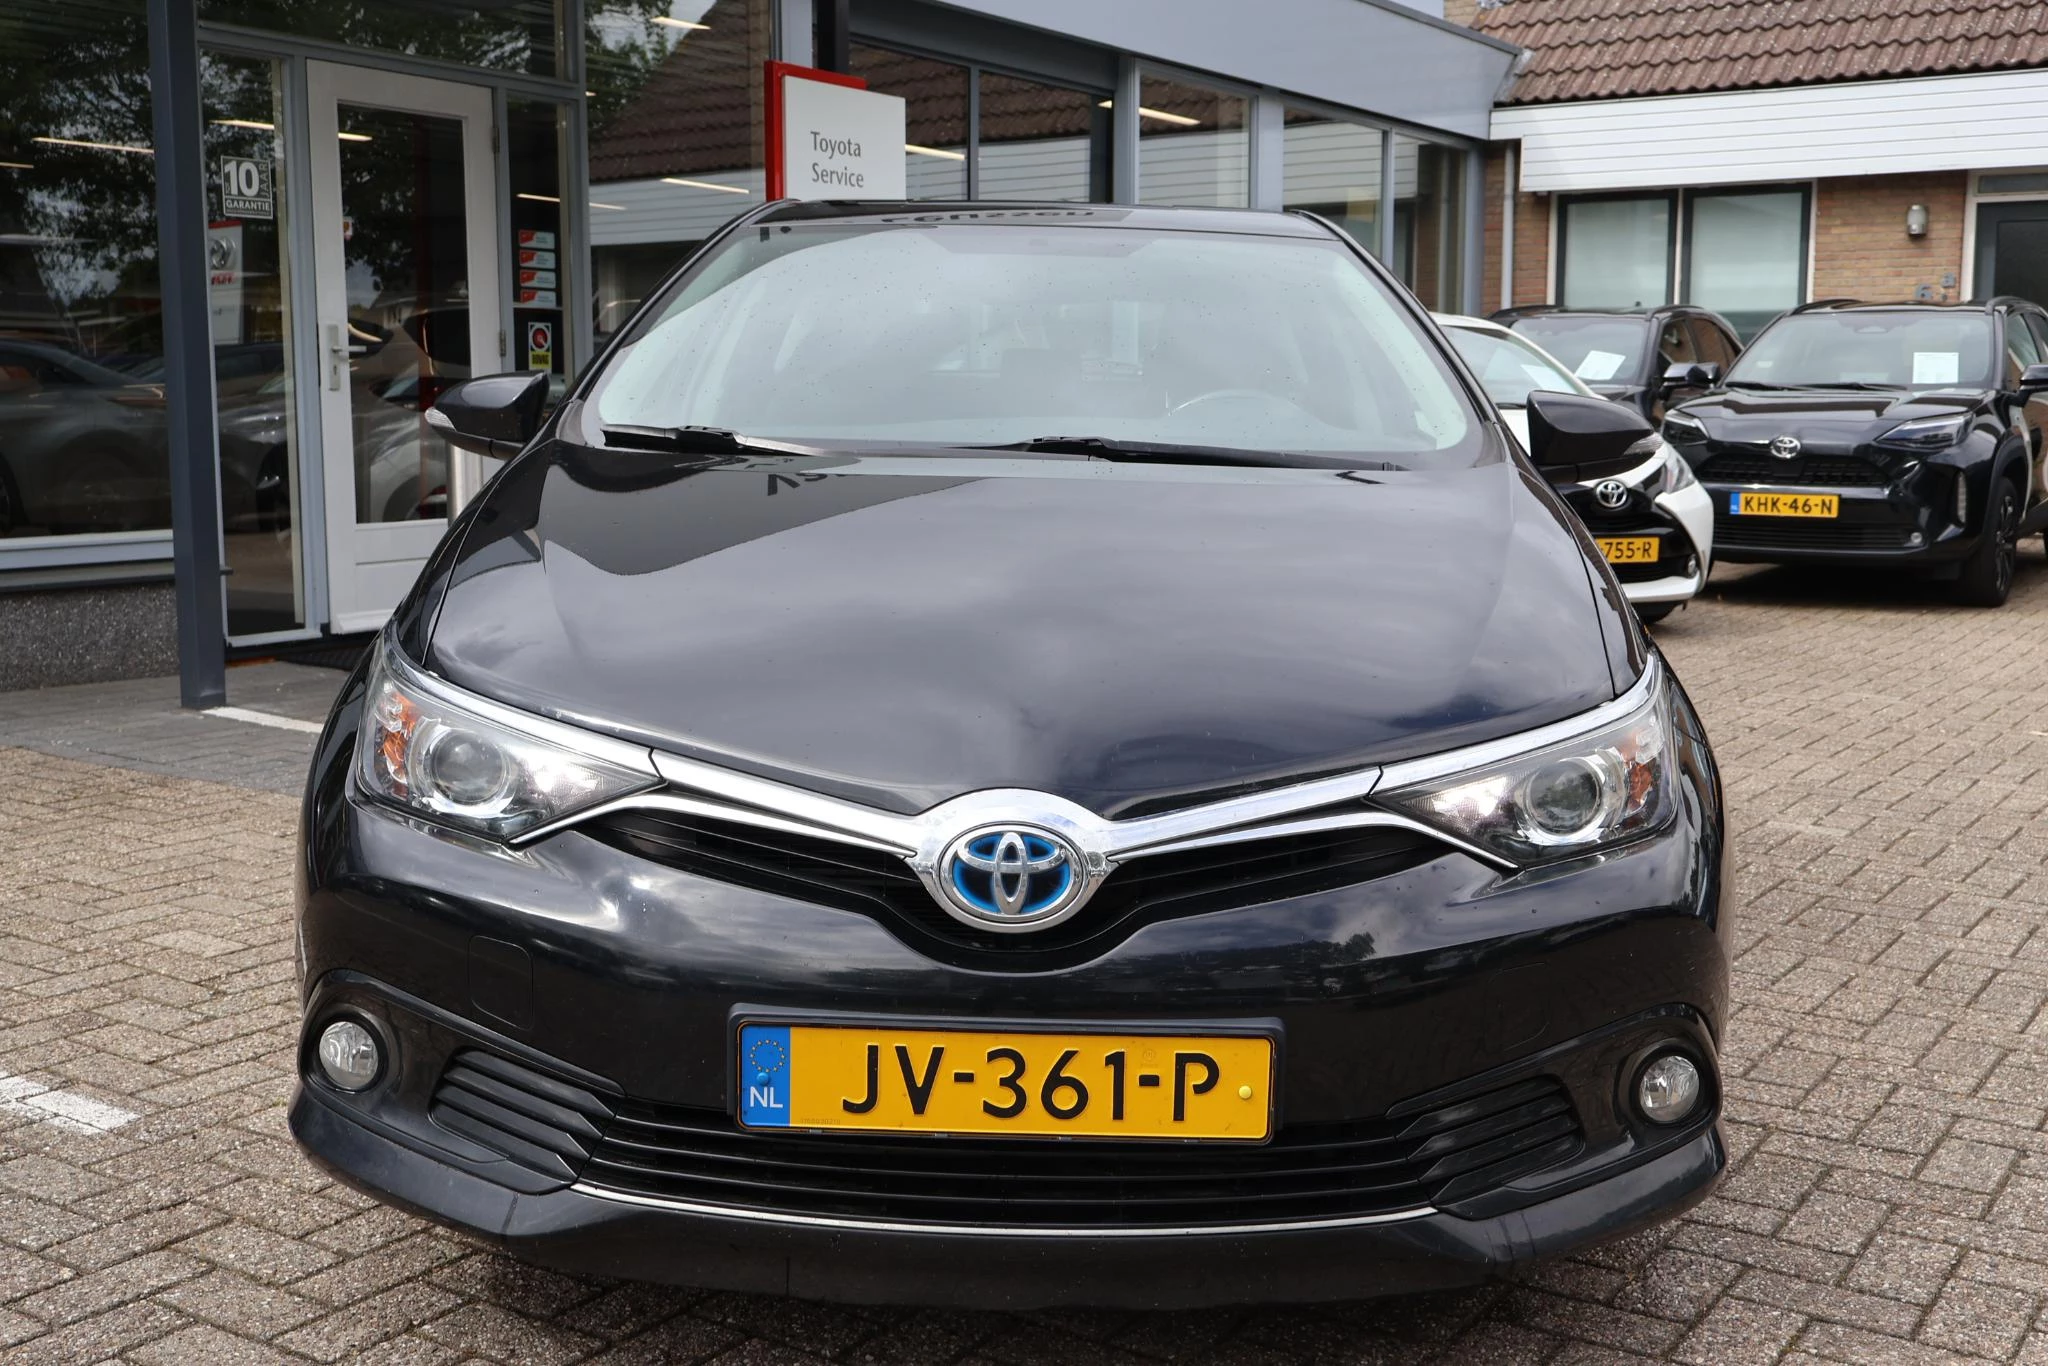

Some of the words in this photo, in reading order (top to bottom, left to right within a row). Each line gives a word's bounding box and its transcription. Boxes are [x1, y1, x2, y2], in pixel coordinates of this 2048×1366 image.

[810, 130, 862, 160] Toyota
[224, 160, 259, 197] 10
[811, 162, 864, 188] Service
[226, 199, 270, 211] GARANTIE
[1743, 495, 1834, 515] KHK-46-N
[1600, 540, 1653, 559] -755-R
[842, 1043, 1220, 1122] JV-361-P
[749, 1085, 784, 1108] NL
